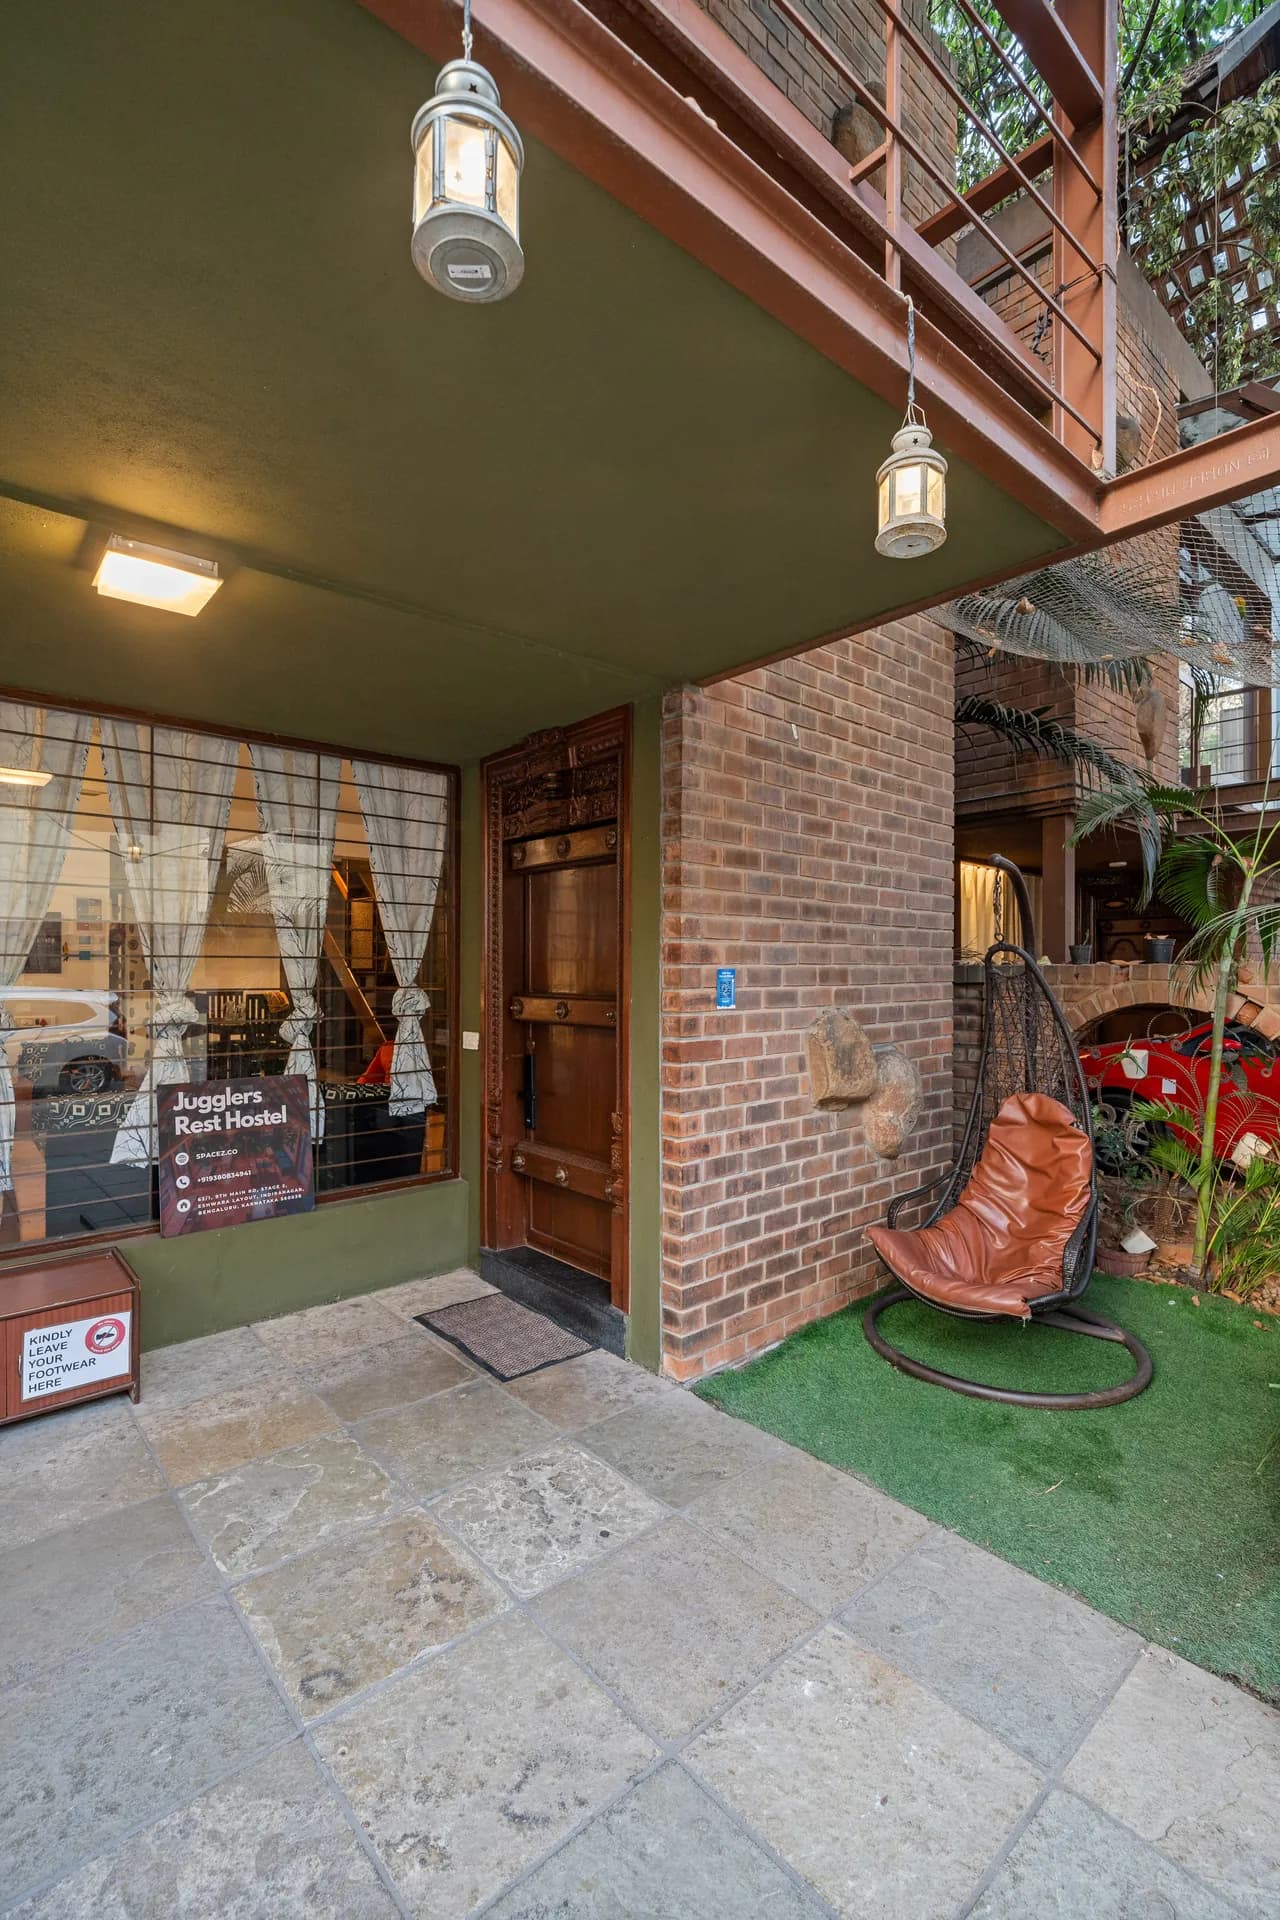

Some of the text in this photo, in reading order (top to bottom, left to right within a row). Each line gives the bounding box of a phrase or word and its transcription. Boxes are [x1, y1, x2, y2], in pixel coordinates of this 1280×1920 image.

[173, 1087, 263, 1113] Jugglers
[174, 1105, 287, 1135] Rest Hostel
[196, 1149, 238, 1160] SPACEZ.CO
[261, 1184, 280, 1192] STAGE
[241, 1197, 279, 1208] KARNATAKA
[29, 1329, 73, 1345] KINDLY
[29, 1341, 68, 1357] LEAVE
[28, 1354, 63, 1369] YOUR
[28, 1357, 97, 1381] FOOTWEAR
[28, 1377, 62, 1393] HERE
